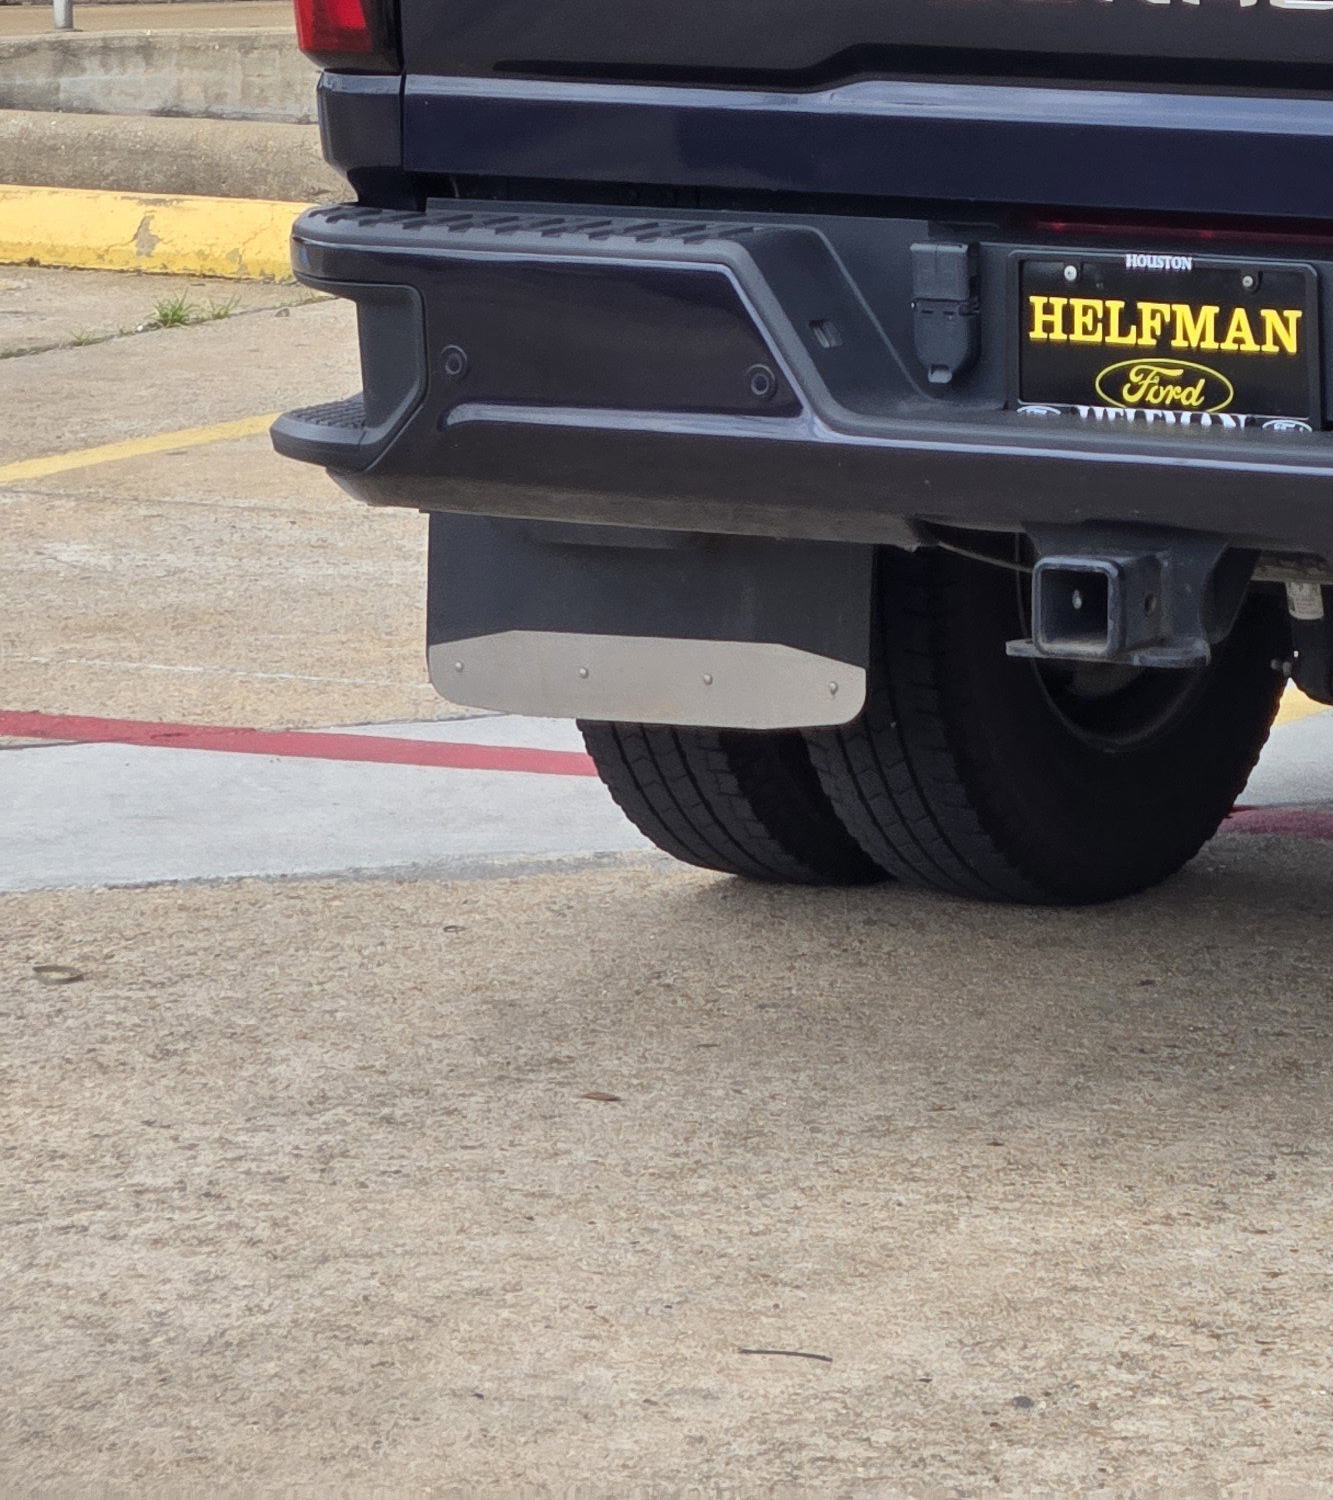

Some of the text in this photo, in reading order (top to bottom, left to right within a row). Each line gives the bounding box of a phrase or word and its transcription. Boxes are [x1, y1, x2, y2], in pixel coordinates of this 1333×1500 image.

[1125, 254, 1193, 271] HOUSTON
[1029, 295, 1302, 354] HELFMAN
[1122, 365, 1206, 407] Ford
